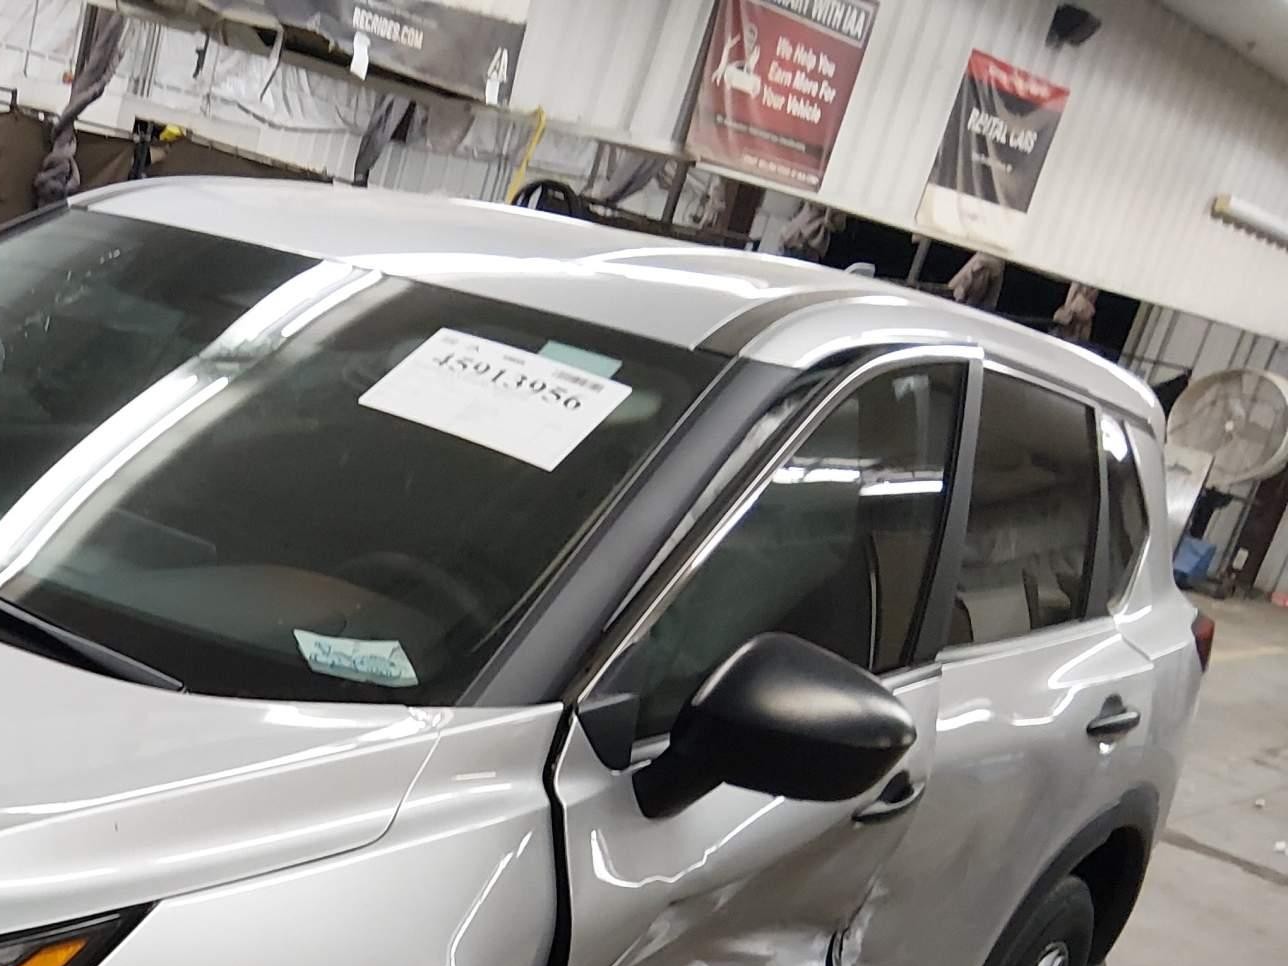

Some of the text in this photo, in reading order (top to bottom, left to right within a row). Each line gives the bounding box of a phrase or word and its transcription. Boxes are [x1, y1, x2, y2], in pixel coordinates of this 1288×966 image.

[812, 0, 845, 30] WITH
[841, 4, 866, 39] IAA
[776, 34, 836, 78] We Help You
[767, 60, 836, 104] Earn More For
[762, 83, 821, 124] Your Vehicle
[967, 107, 1008, 144] RENTAL
